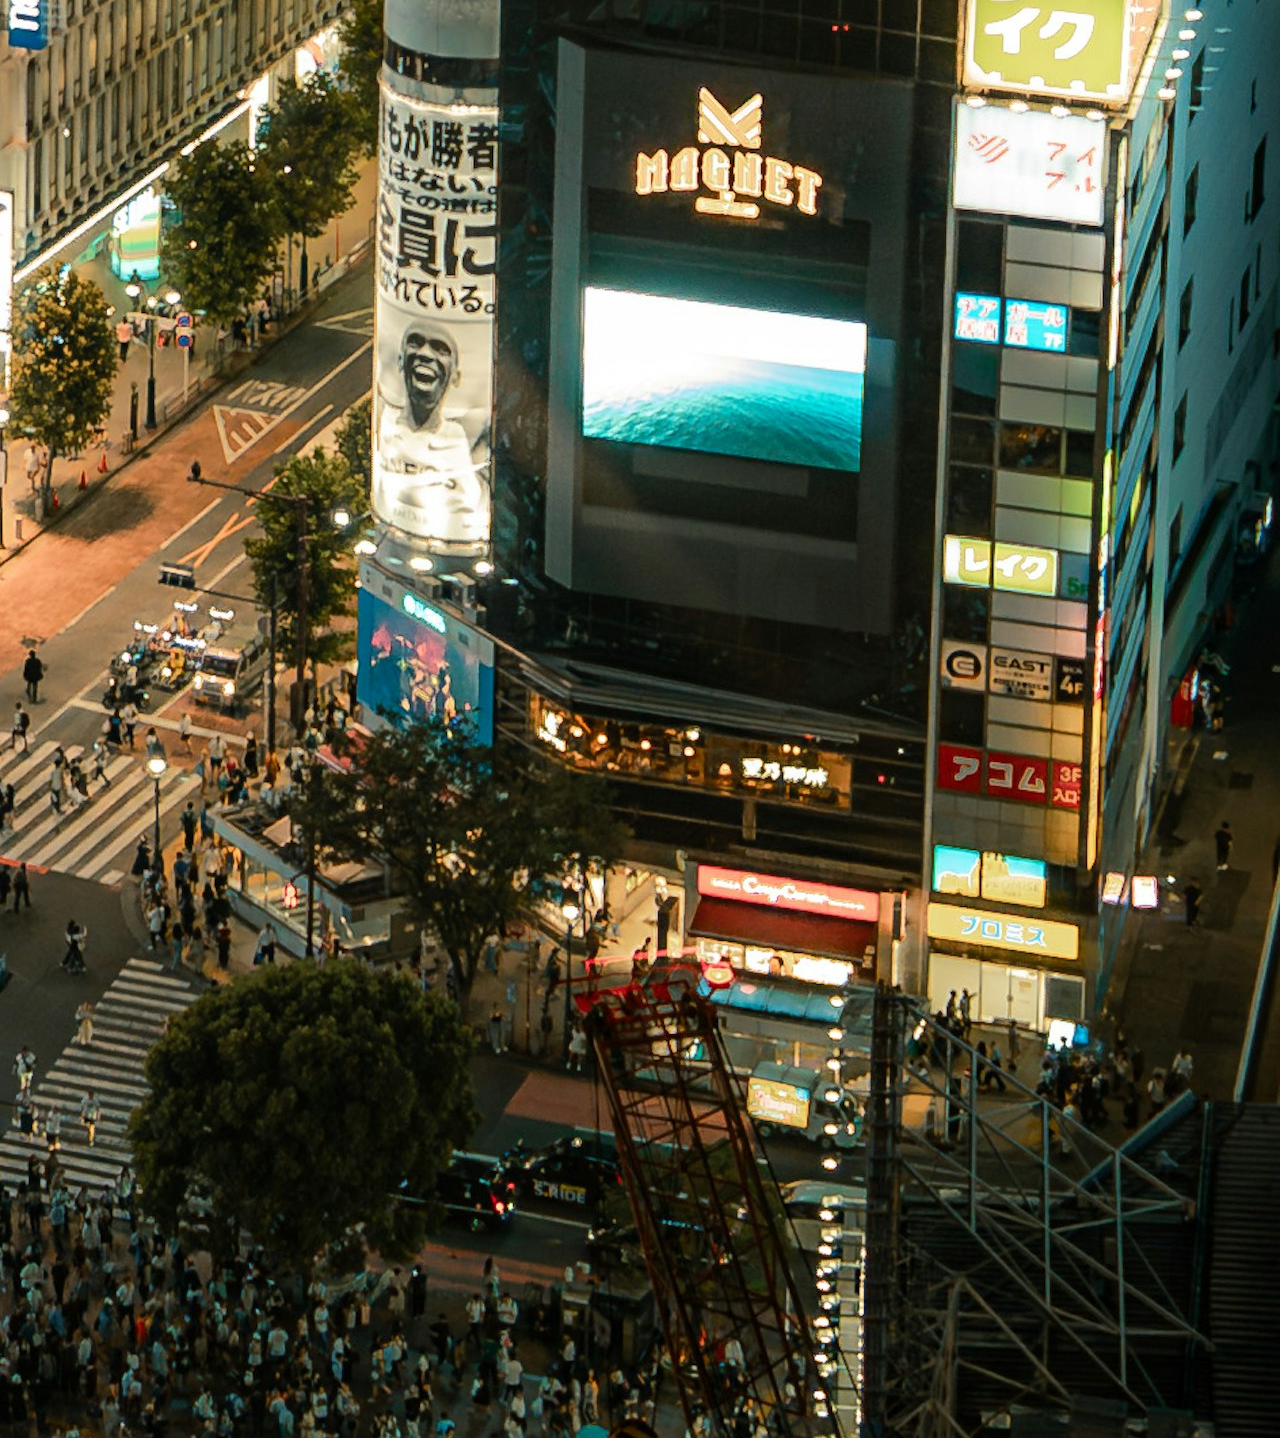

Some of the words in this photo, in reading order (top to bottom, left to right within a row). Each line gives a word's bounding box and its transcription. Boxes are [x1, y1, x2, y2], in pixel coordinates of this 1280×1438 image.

[984, 7, 1095, 60] イク
[381, 103, 500, 170] もが勝者
[636, 146, 823, 216] MAGNET
[964, 546, 1048, 581] レイク
[994, 655, 1052, 675] EAST
[1059, 675, 1084, 695] 4F
[952, 756, 1046, 794] アコム
[959, 915, 1047, 948] プロミス
